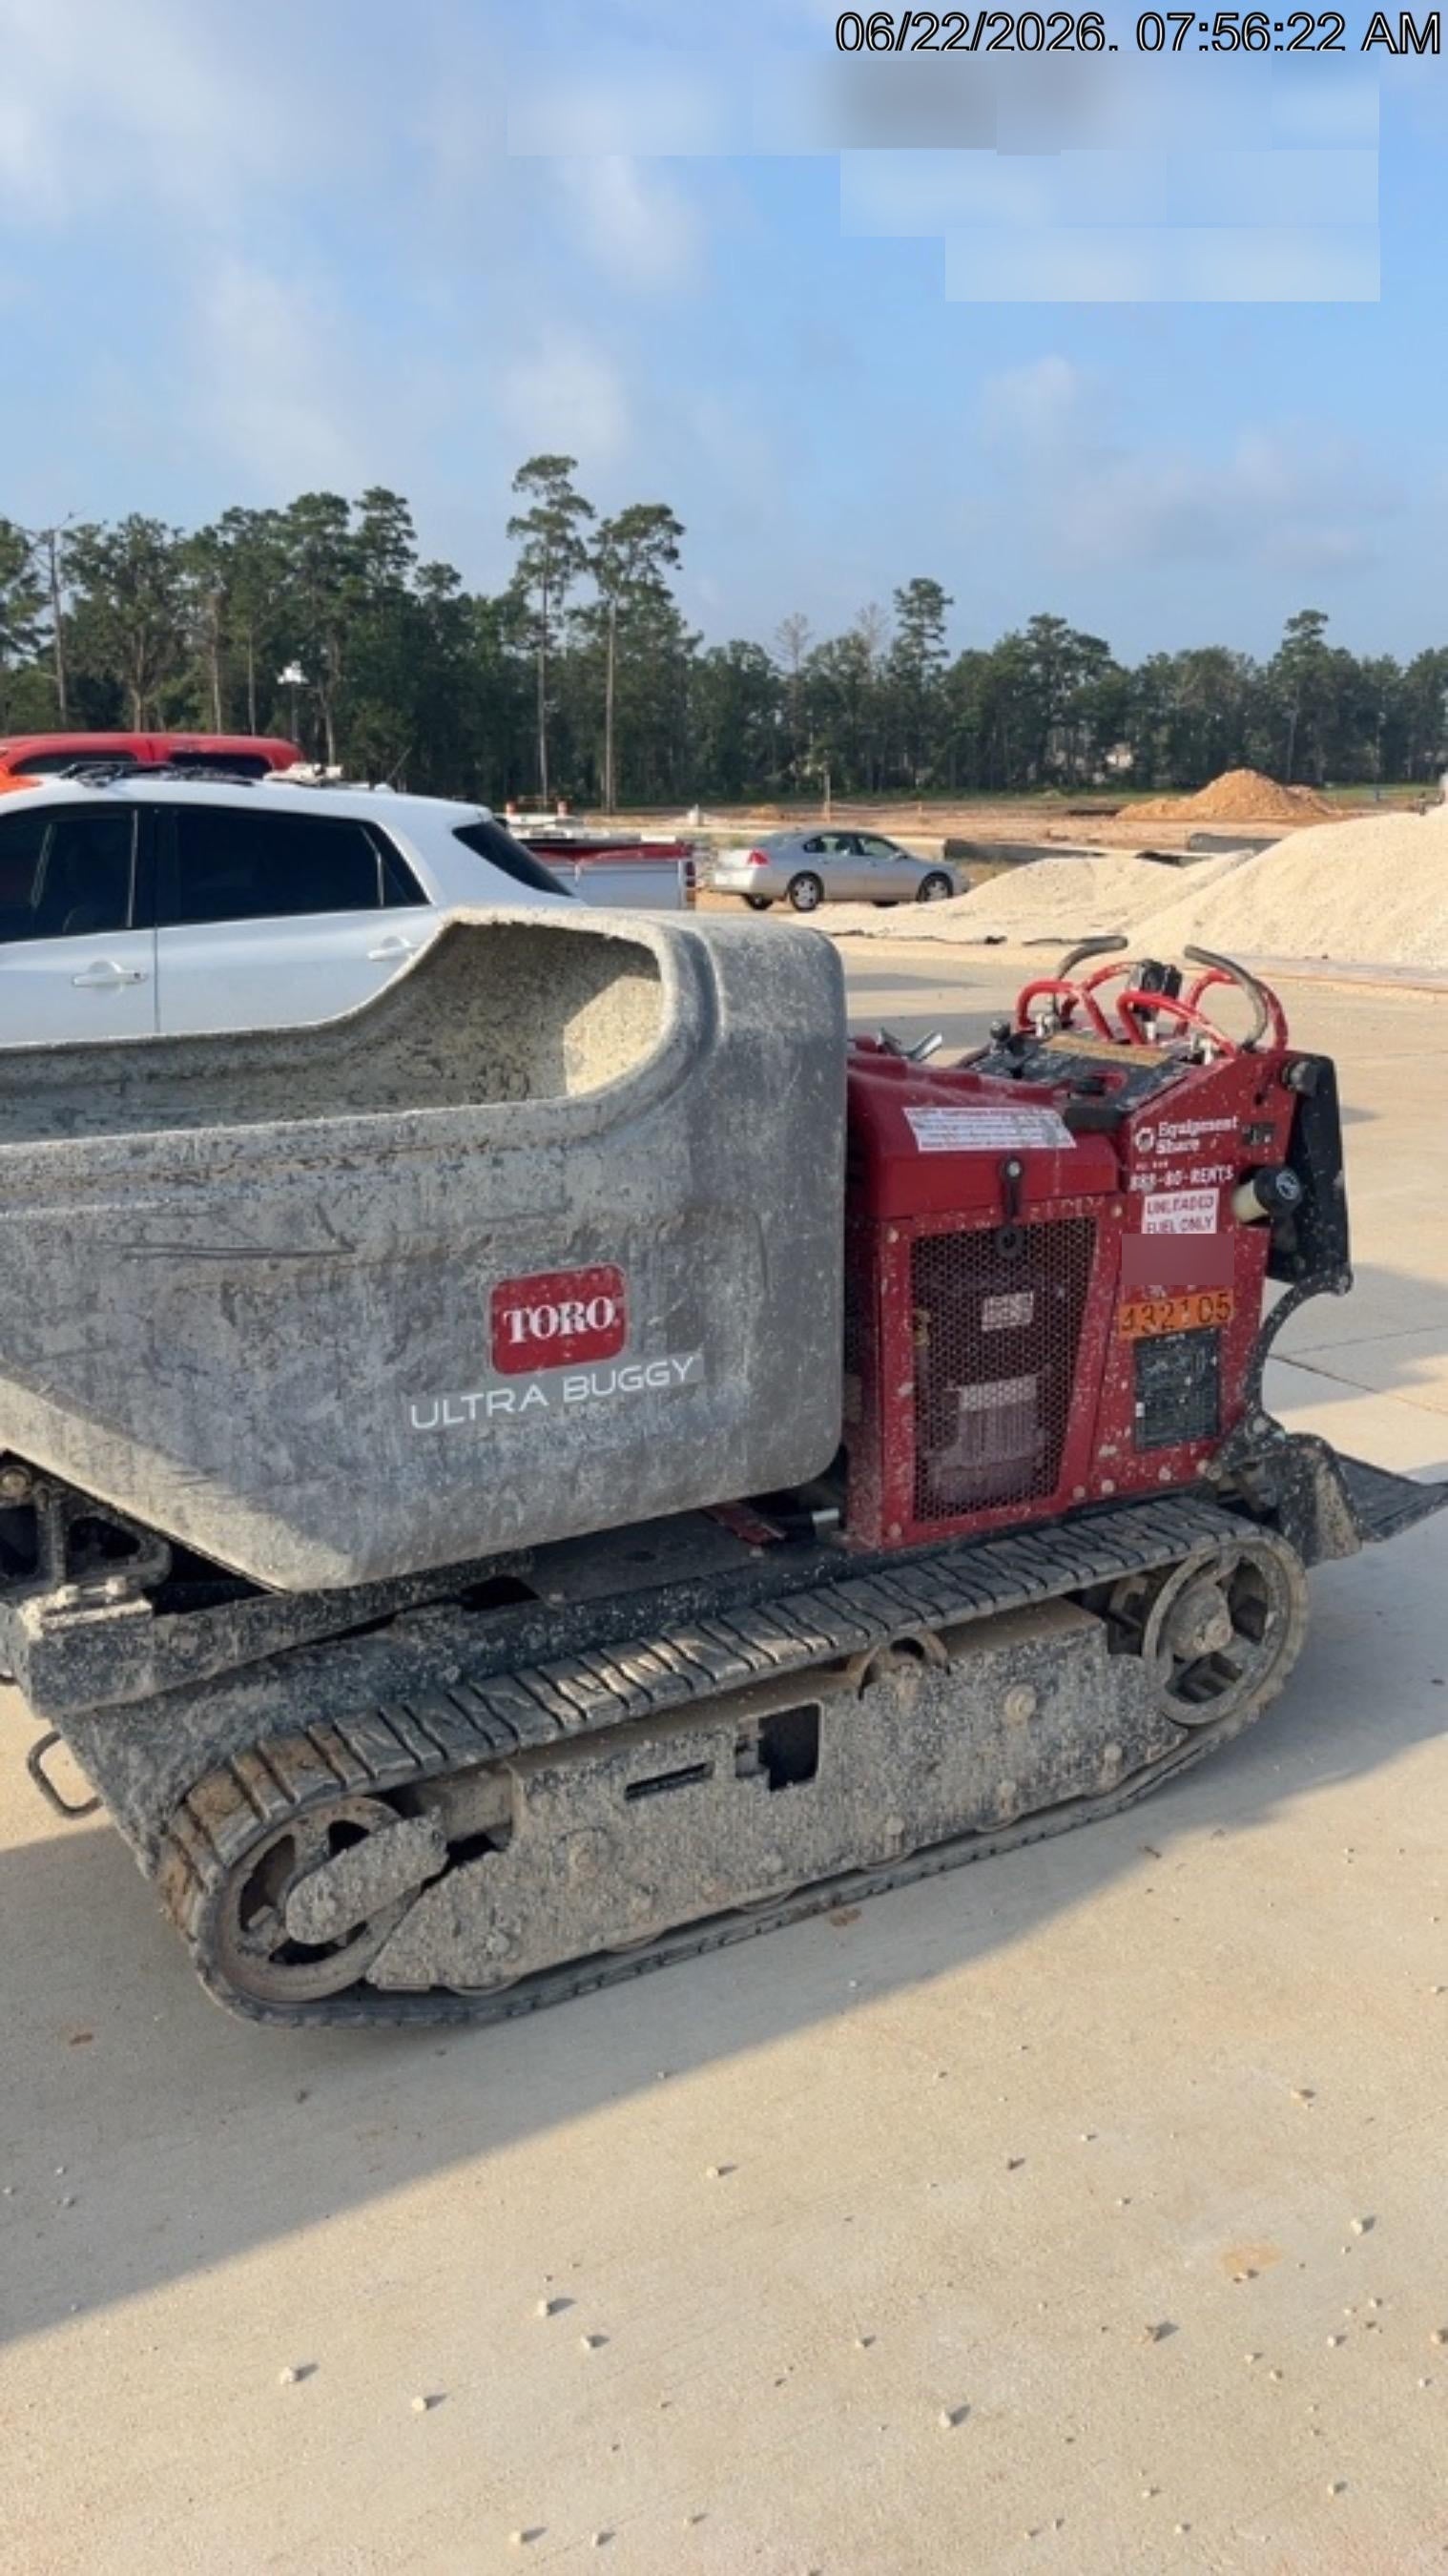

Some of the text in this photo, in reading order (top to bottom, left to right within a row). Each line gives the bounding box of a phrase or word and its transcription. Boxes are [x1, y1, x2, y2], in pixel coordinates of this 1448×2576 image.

[1158, 1115, 1238, 1139] Equipment
[1155, 1137, 1201, 1154] Share
[1147, 1195, 1214, 1215] UNLEADED
[1147, 1215, 1213, 1234] FUEL ONLY
[504, 1297, 615, 1344] TORO
[411, 1356, 694, 1429] ULTRA BUGGY
